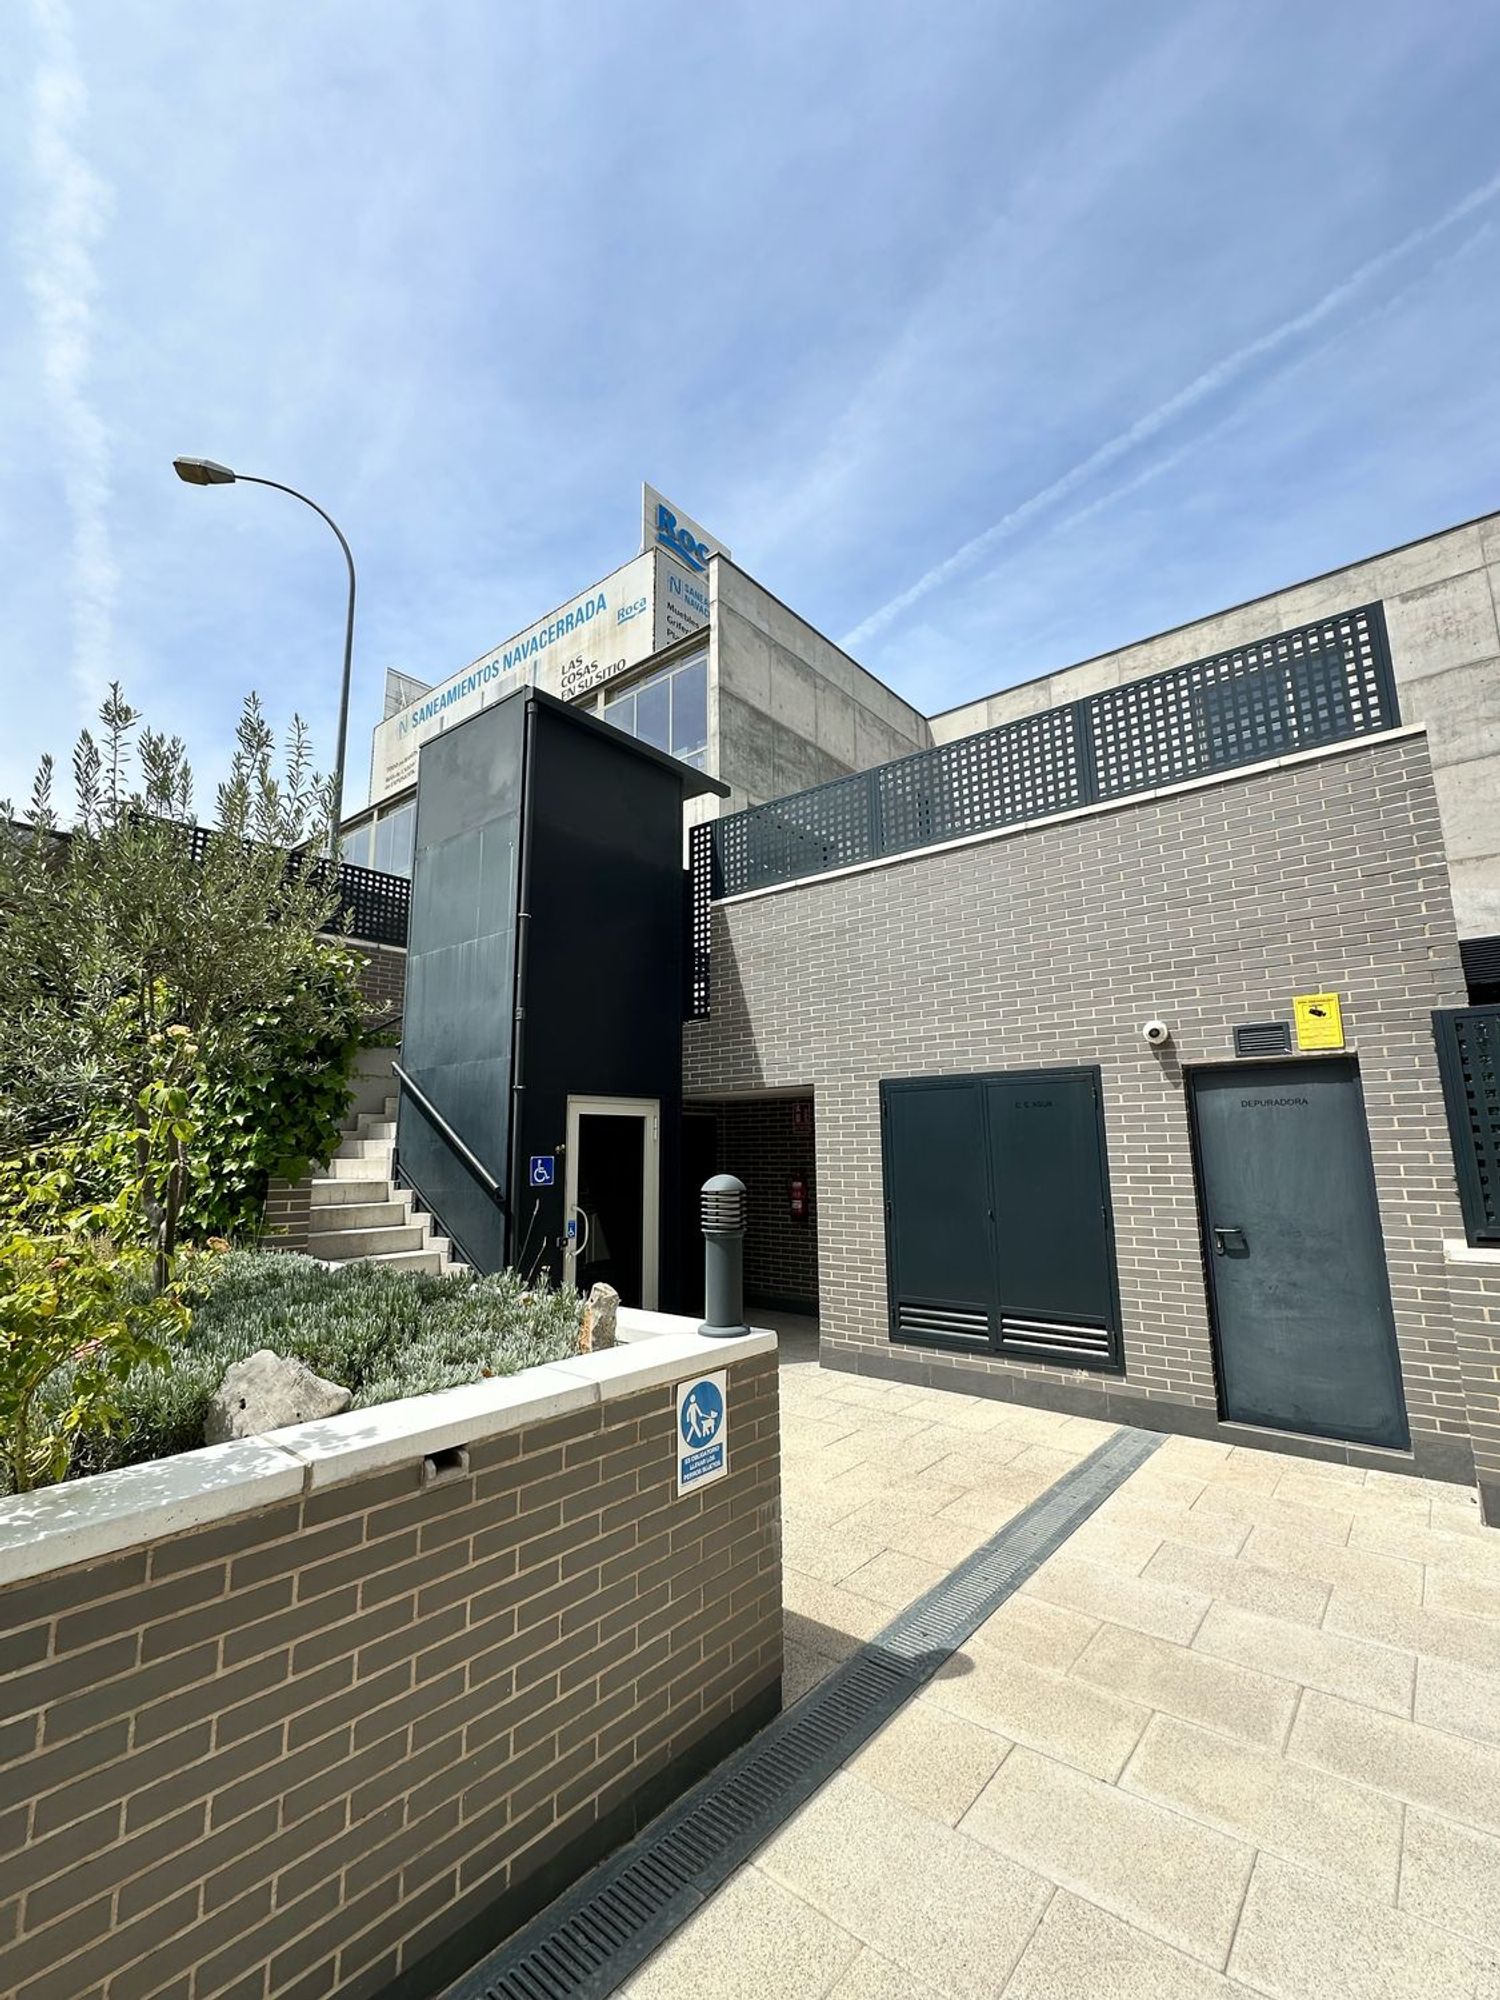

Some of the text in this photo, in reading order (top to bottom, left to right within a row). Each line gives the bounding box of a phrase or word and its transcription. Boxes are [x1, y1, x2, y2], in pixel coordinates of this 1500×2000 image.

[656, 502, 710, 563] Roc
[617, 596, 647, 621] Roca
[667, 602, 700, 629] Muebles
[684, 595, 710, 619] NAVAC
[666, 615, 692, 635] Grifer
[412, 660, 500, 729] SANEAMIENTOS
[502, 592, 608, 681] NAVACERRADA
[561, 655, 583, 675] LAS
[561, 660, 599, 688] COSAS
[561, 659, 626, 701] EN SU SITIO
[1241, 1098, 1309, 1108] DEPURADORA
